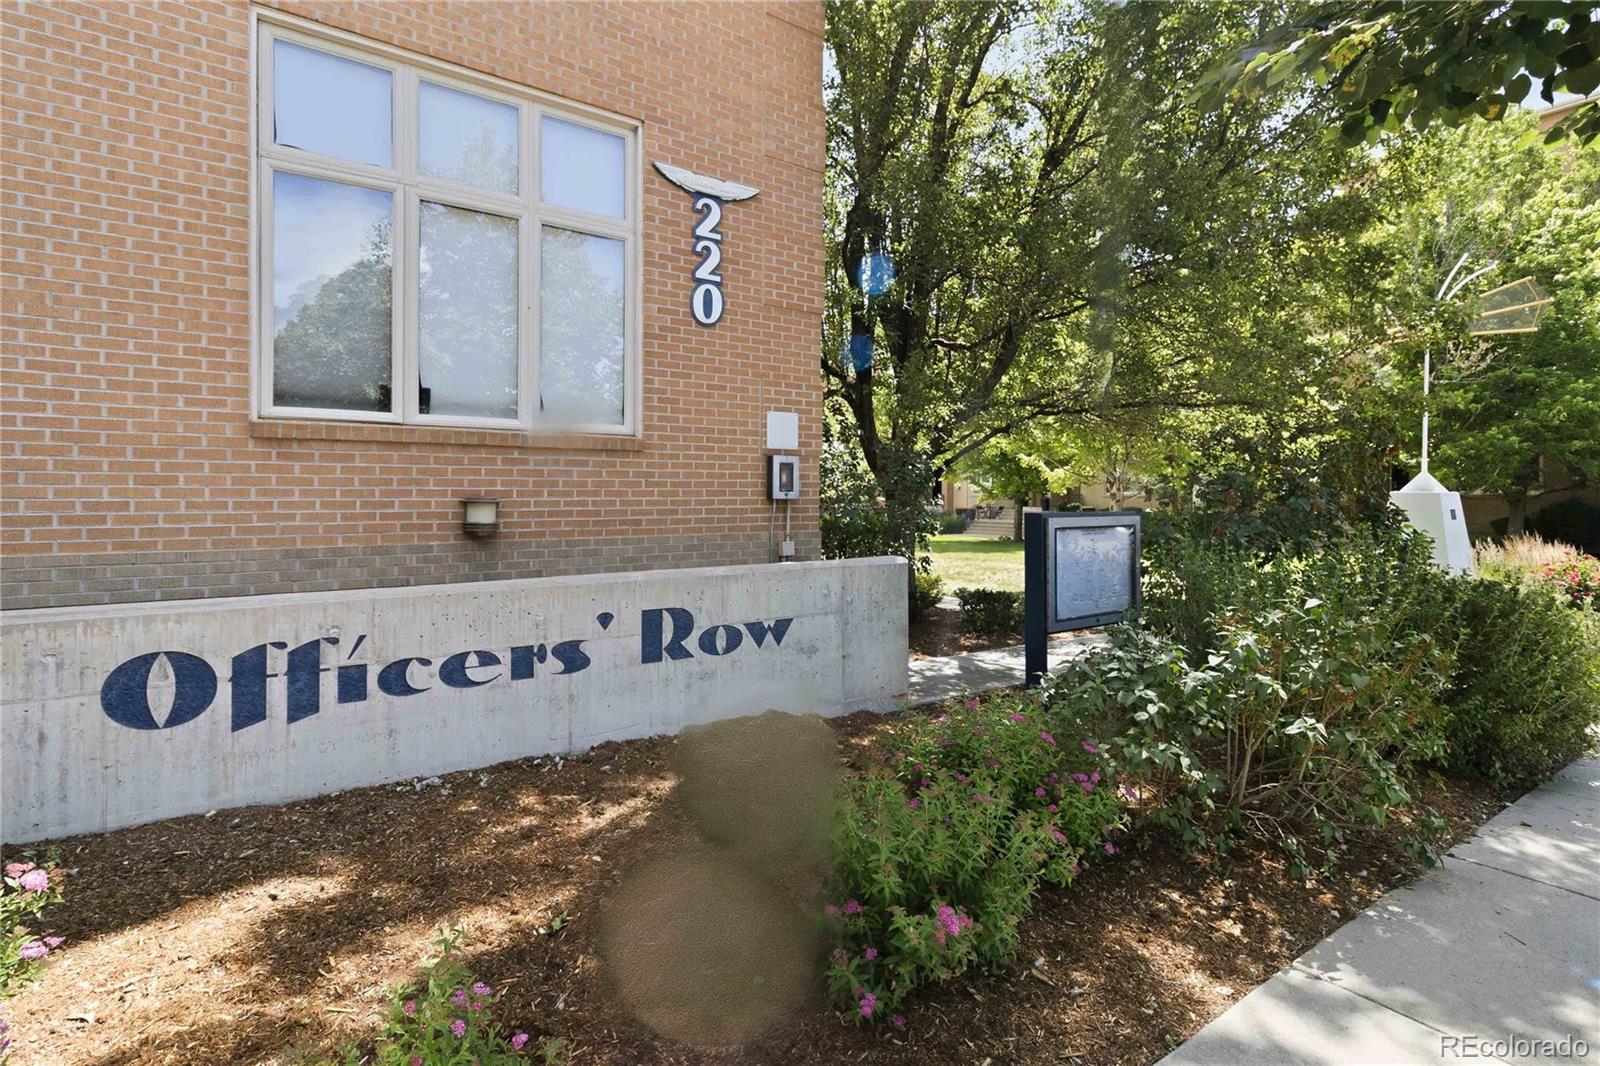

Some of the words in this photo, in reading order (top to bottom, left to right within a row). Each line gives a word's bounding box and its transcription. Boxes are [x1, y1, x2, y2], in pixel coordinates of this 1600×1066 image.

[692, 197, 723, 324] 220
[100, 611, 615, 733] Officers'
[641, 607, 794, 664] Row
